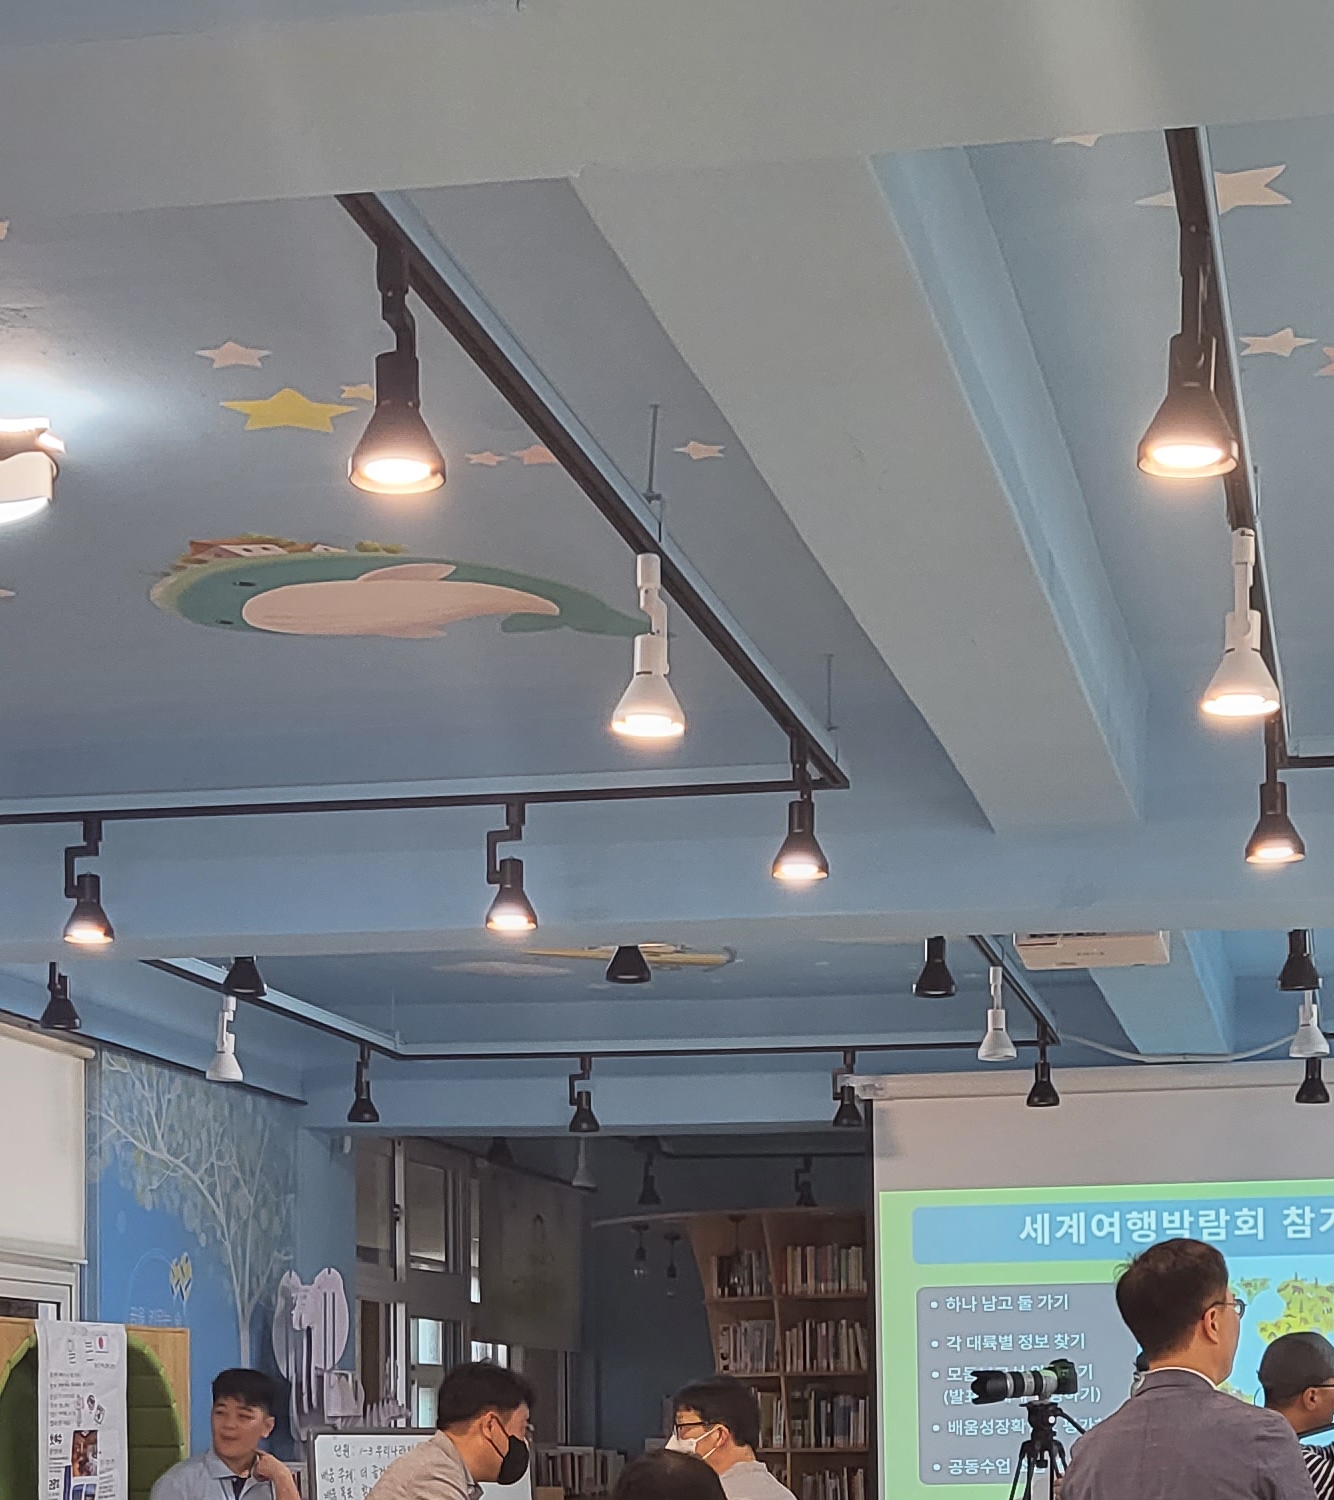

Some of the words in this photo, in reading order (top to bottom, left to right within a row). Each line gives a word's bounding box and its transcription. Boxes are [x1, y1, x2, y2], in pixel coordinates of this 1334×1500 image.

[1019, 1207, 1265, 1245] 세계여행박람회
[945, 1297, 977, 1312] 하나
[982, 1296, 1014, 1311] 남고
[1017, 1295, 1033, 1311] 둘
[1037, 1294, 1069, 1310] 가기
[946, 1336, 962, 1352] 각
[966, 1334, 1014, 1351] 대륙별
[1018, 1334, 1050, 1350] 정보
[1054, 1333, 1085, 1349] 찾기
[948, 1458, 1011, 1475] 공동수업
